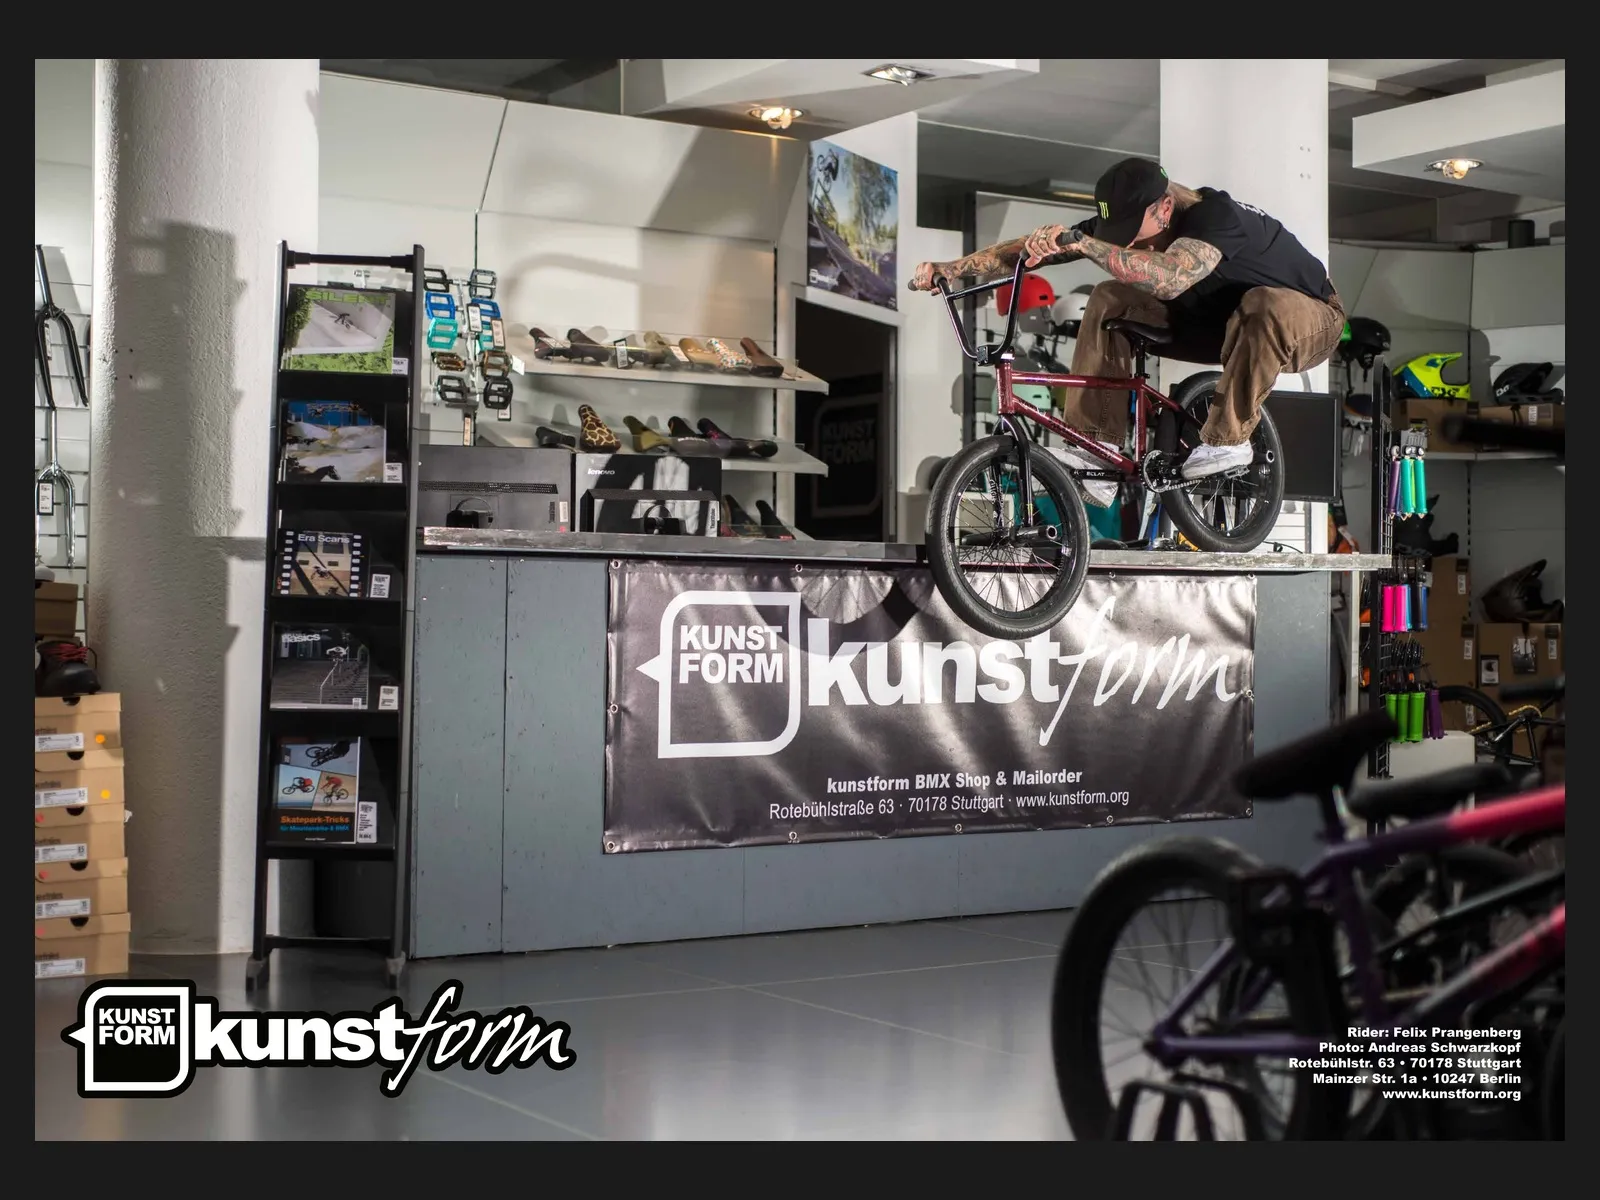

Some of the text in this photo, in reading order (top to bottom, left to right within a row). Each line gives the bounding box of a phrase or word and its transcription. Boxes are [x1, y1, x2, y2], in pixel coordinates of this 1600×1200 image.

[298, 533, 350, 544] Era Scans
[680, 625, 783, 651] KUNST
[679, 652, 784, 684] FORM
[807, 596, 1236, 747] kunstform
[827, 769, 1083, 794] kunstform BMX Shop & Mailorder
[769, 790, 1130, 820] Rotebühlstraße 63 70178 Stuttgart www.kunstform.org
[280, 815, 350, 825] Skatepark-Tricks
